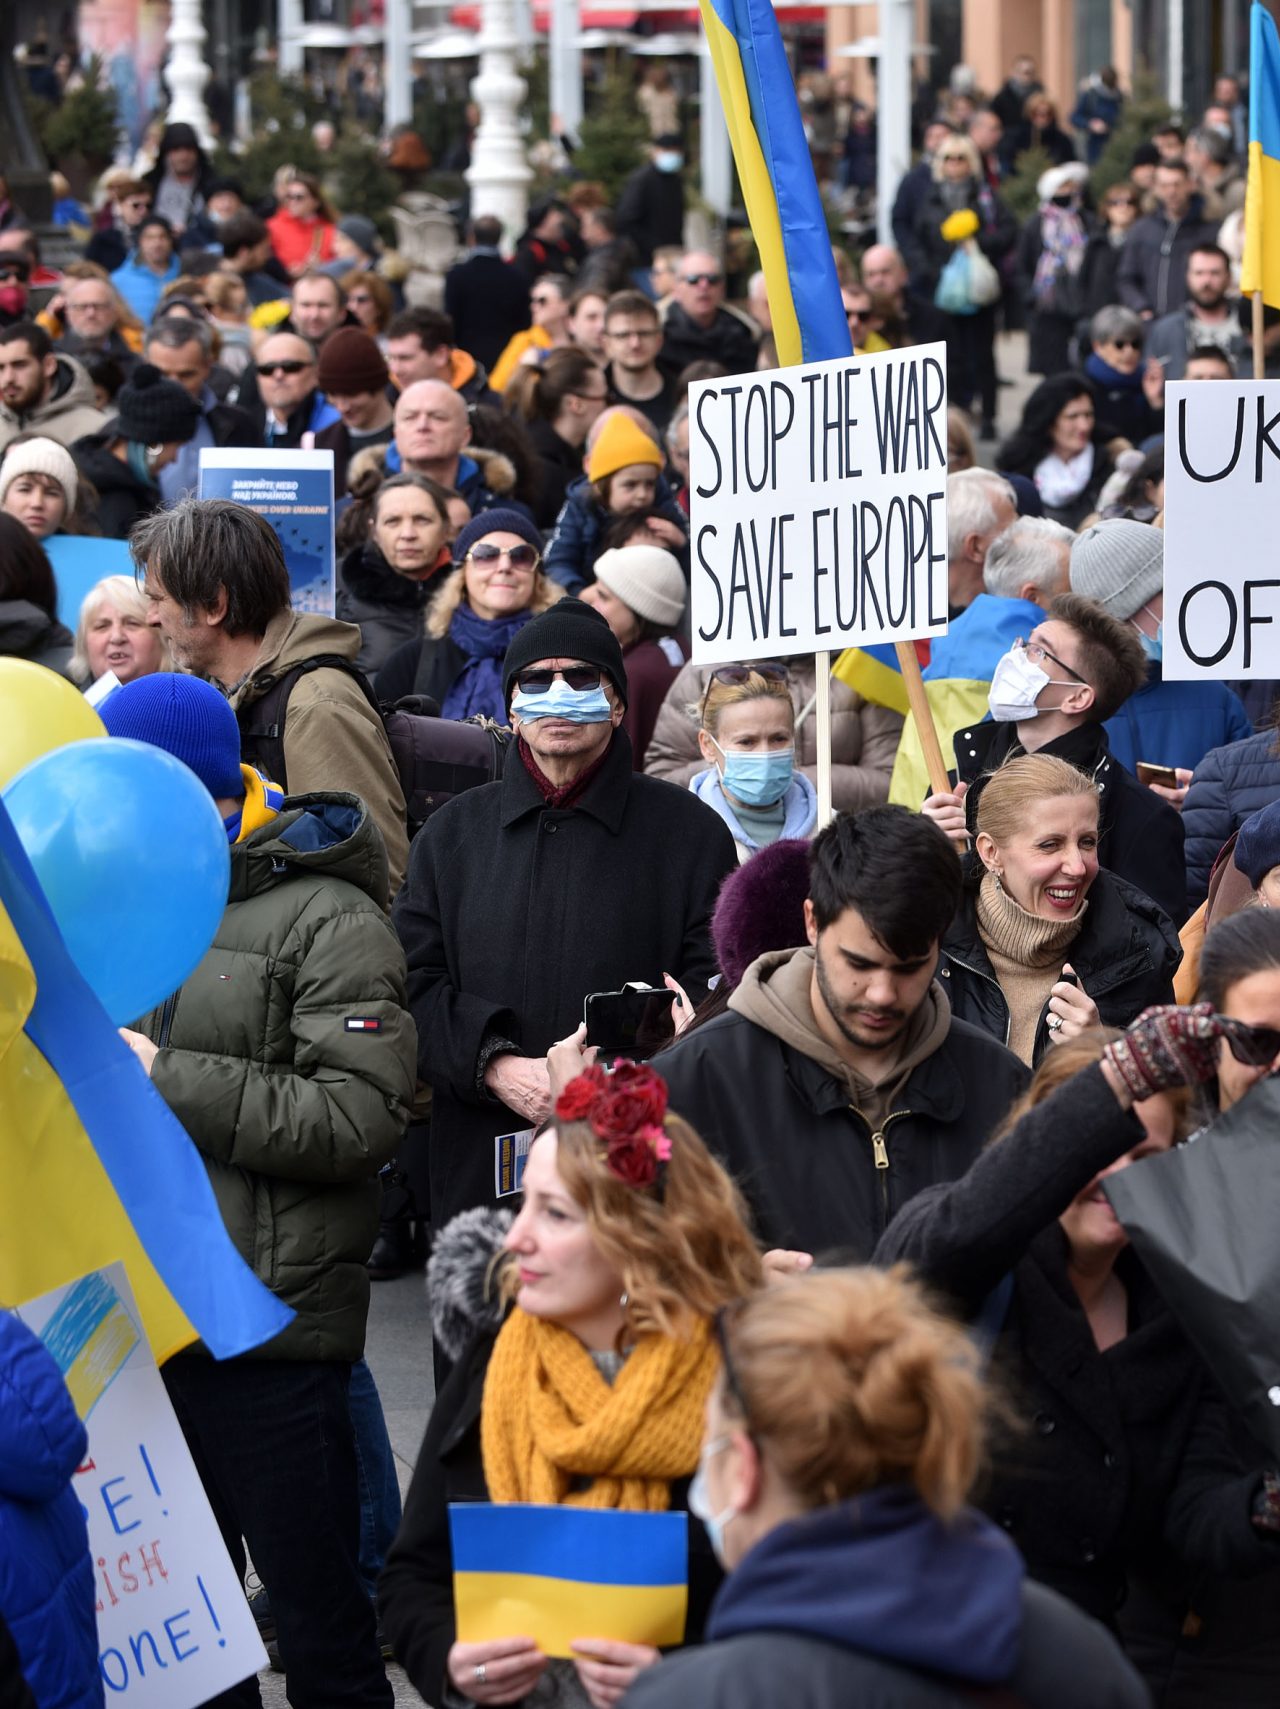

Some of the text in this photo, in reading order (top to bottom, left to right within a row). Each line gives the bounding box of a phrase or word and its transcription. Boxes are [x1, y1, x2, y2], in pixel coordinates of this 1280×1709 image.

[696, 357, 947, 498] STOP THE WAR
[270, 505, 292, 514] OVER
[293, 505, 328, 514] UKRAINE
[697, 491, 947, 641] SAVE EUROPE
